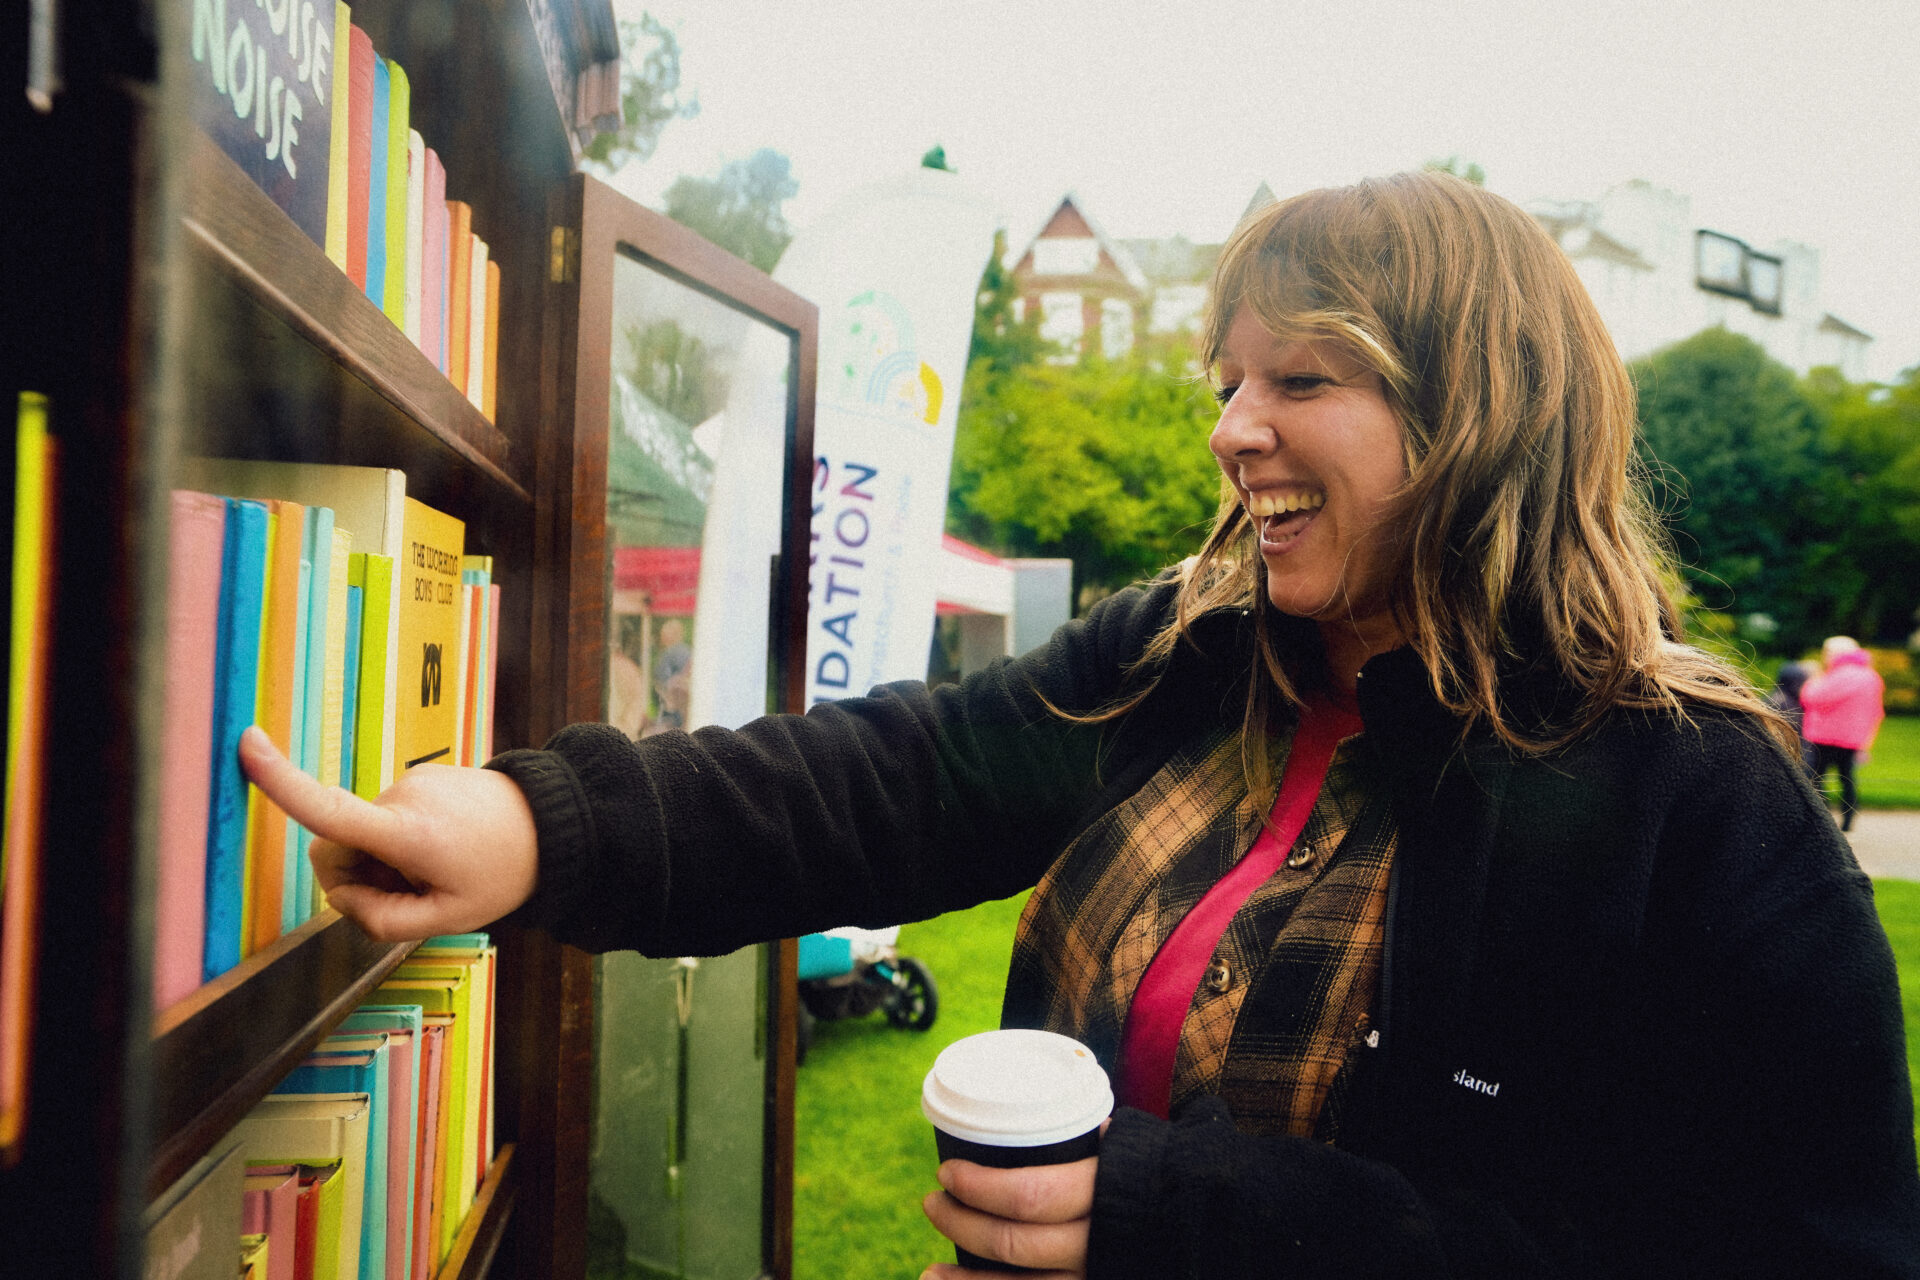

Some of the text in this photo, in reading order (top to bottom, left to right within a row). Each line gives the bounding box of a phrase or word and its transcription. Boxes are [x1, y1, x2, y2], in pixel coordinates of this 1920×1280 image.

[192, 0, 303, 180] NOISE
[412, 541, 458, 576] THE WORKING
[415, 577, 453, 605] BOYS CLUB
[814, 462, 878, 703] DATION
